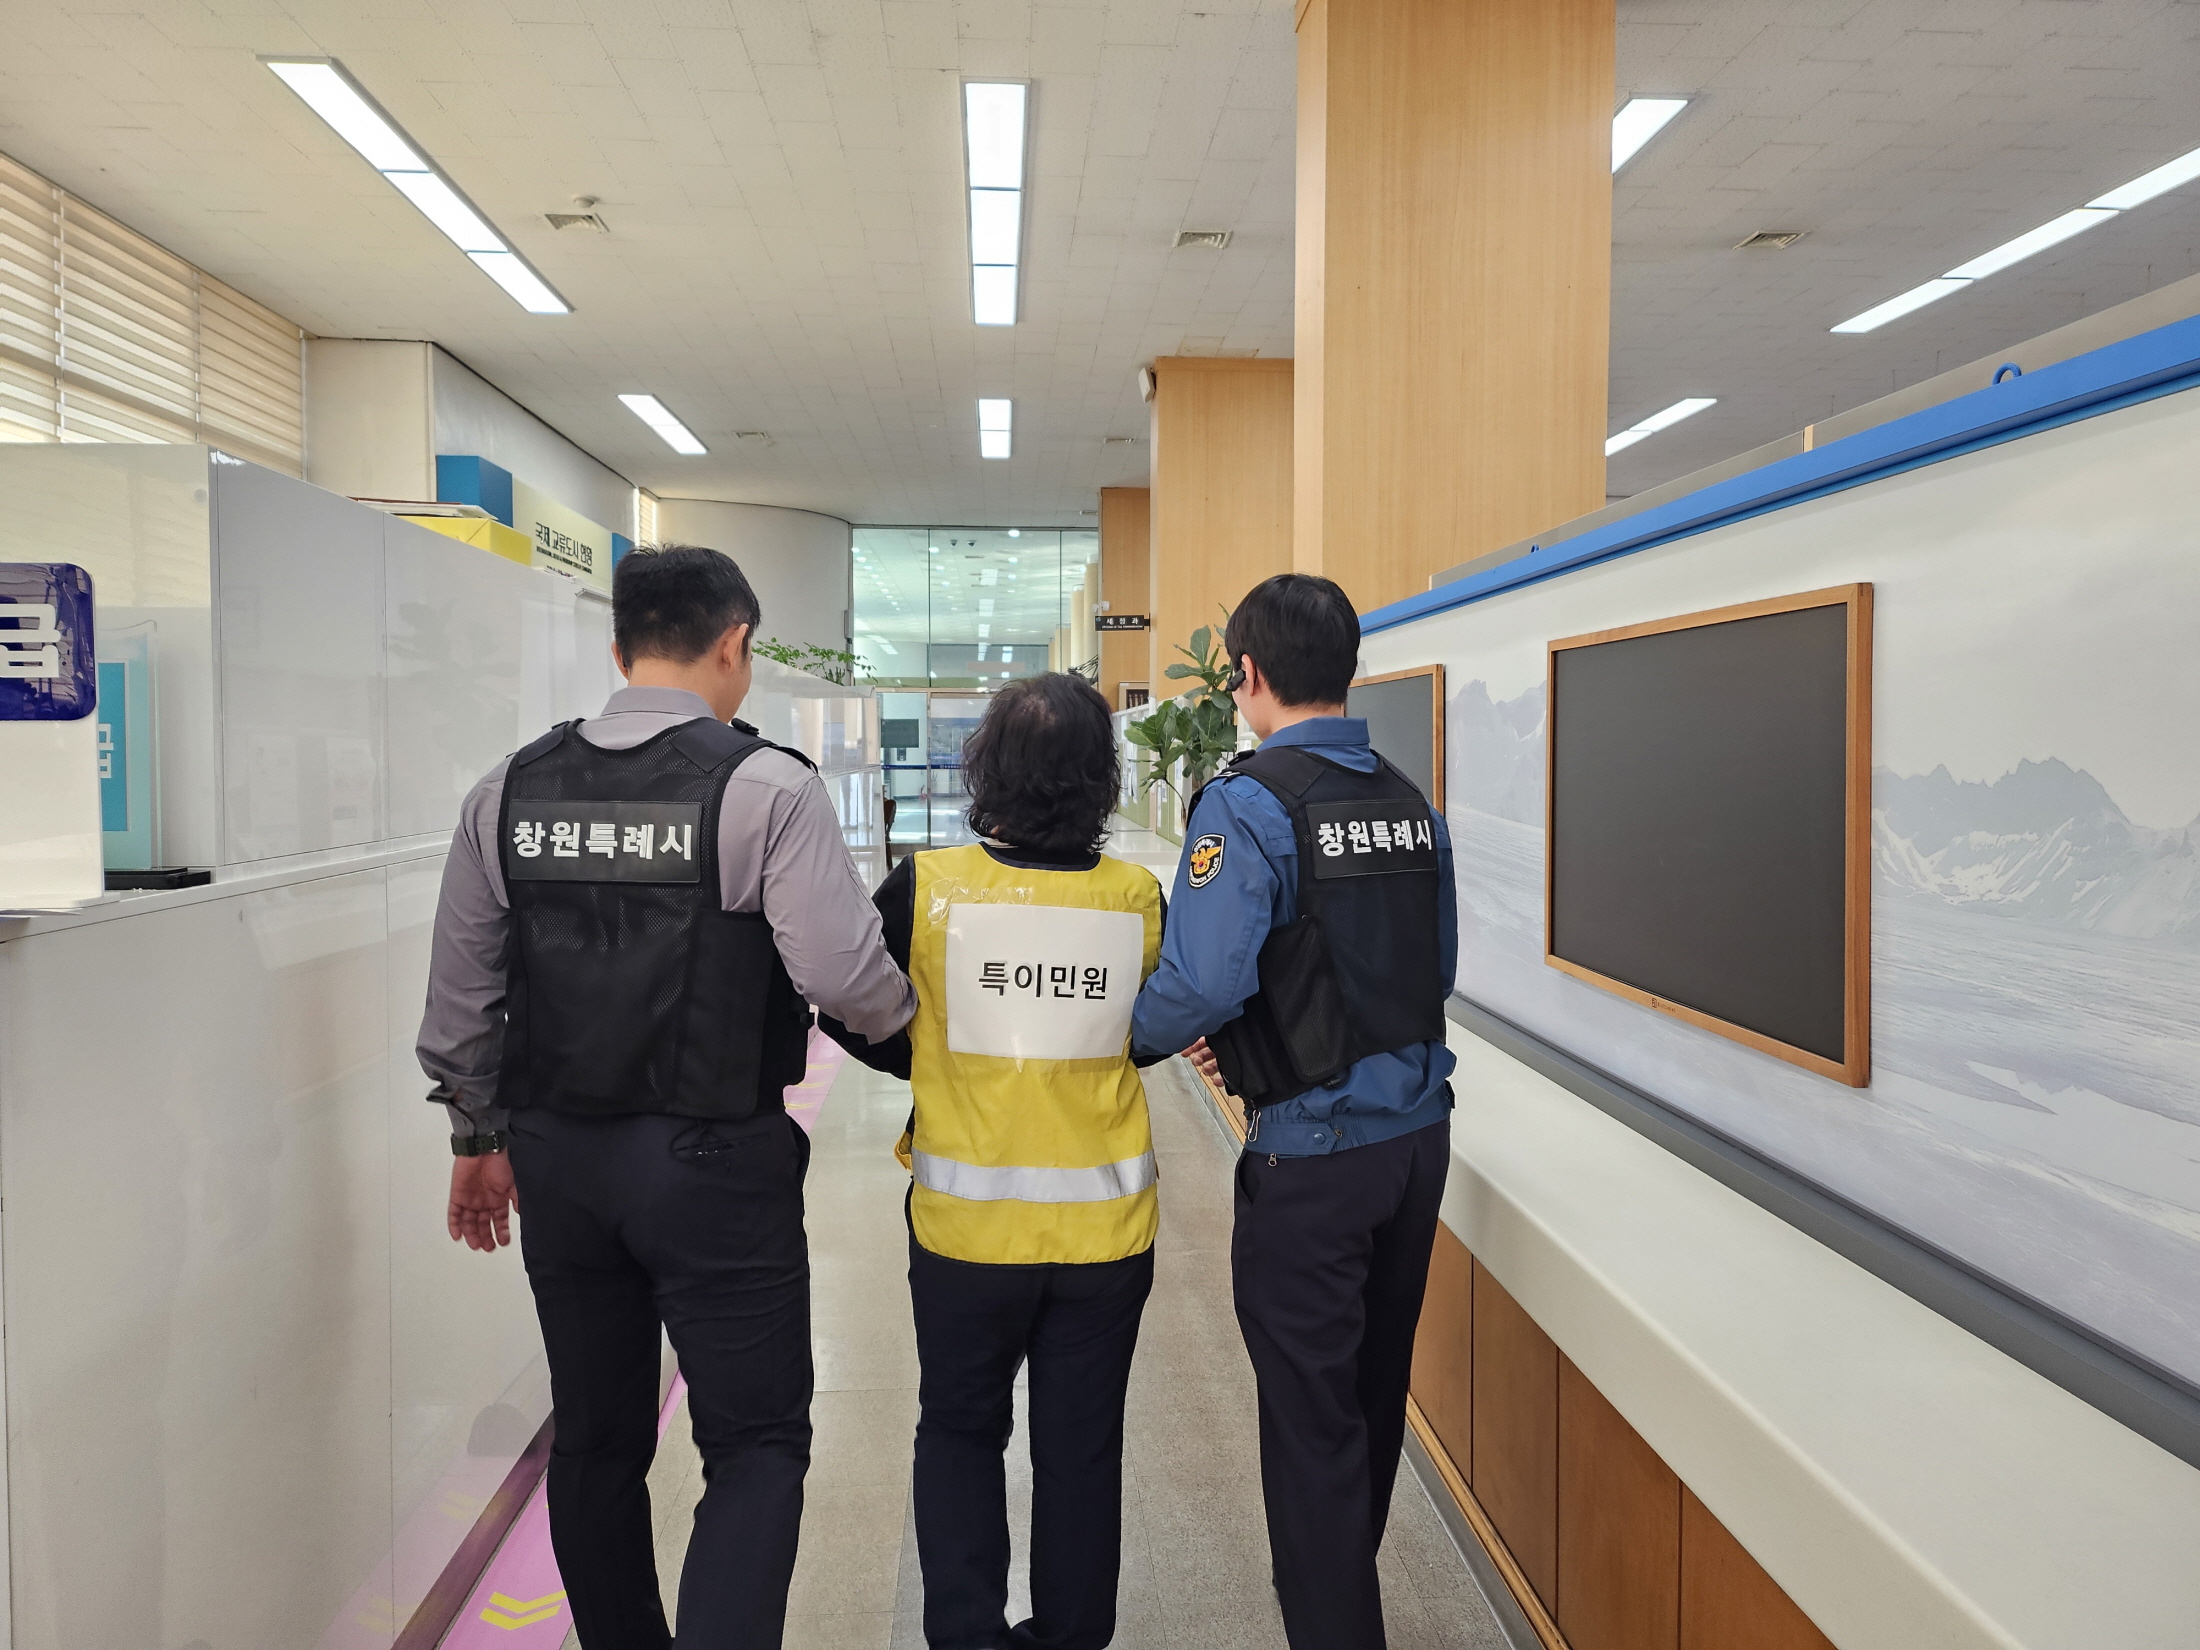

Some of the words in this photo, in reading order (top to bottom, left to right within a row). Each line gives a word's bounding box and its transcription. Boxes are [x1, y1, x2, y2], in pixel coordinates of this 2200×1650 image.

[535, 521, 550, 547] 국제
[552, 530, 579, 560] 교류도시
[512, 821, 692, 861] 창원특례시
[1317, 819, 1433, 857] 창원특례시
[978, 962, 1108, 1000] 특이민원
